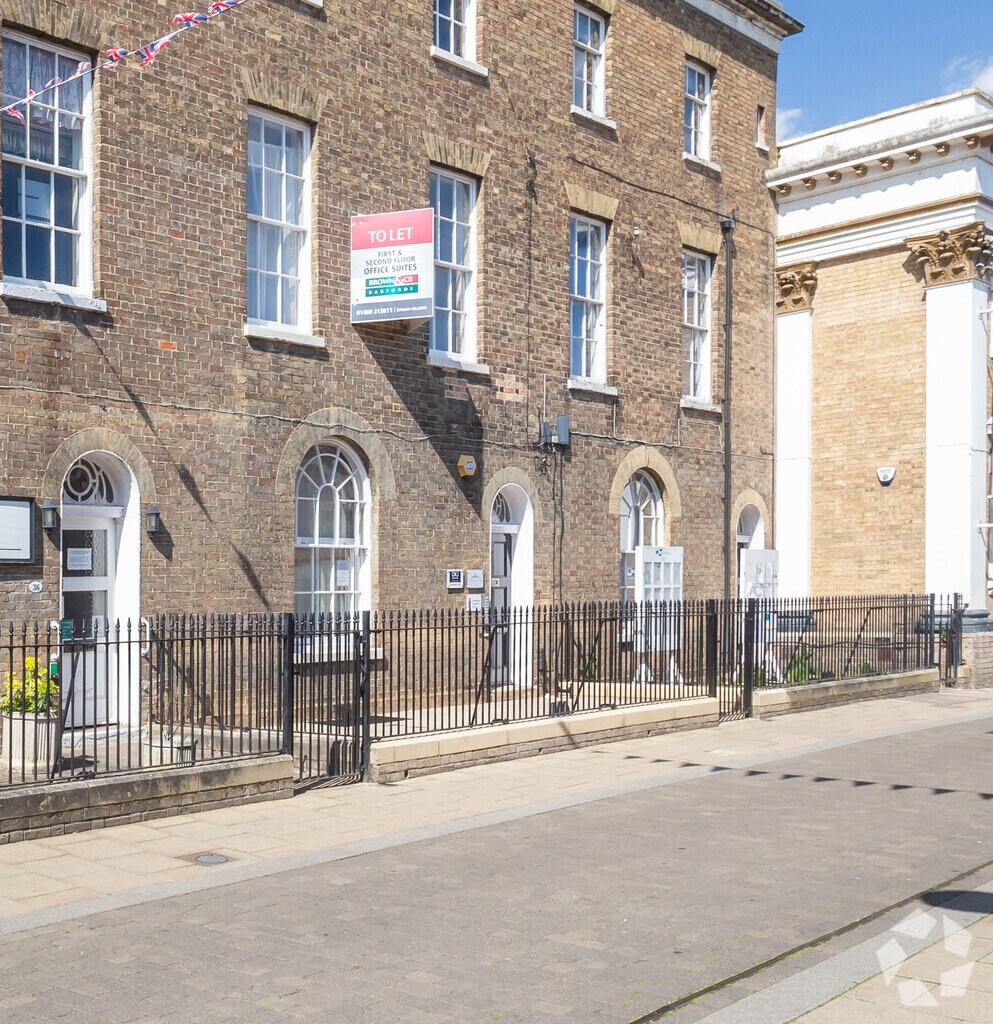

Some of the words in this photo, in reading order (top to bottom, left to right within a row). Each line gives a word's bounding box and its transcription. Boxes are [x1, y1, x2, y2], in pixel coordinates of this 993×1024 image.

[368, 229, 386, 243] TO
[389, 227, 414, 241] LET
[378, 250, 396, 258] FIRST
[366, 257, 392, 266] SECOND
[394, 256, 416, 264] FLOOR
[364, 265, 389, 275] OFFICE
[392, 263, 417, 272] SUITES
[368, 287, 414, 295] BARFORDS
